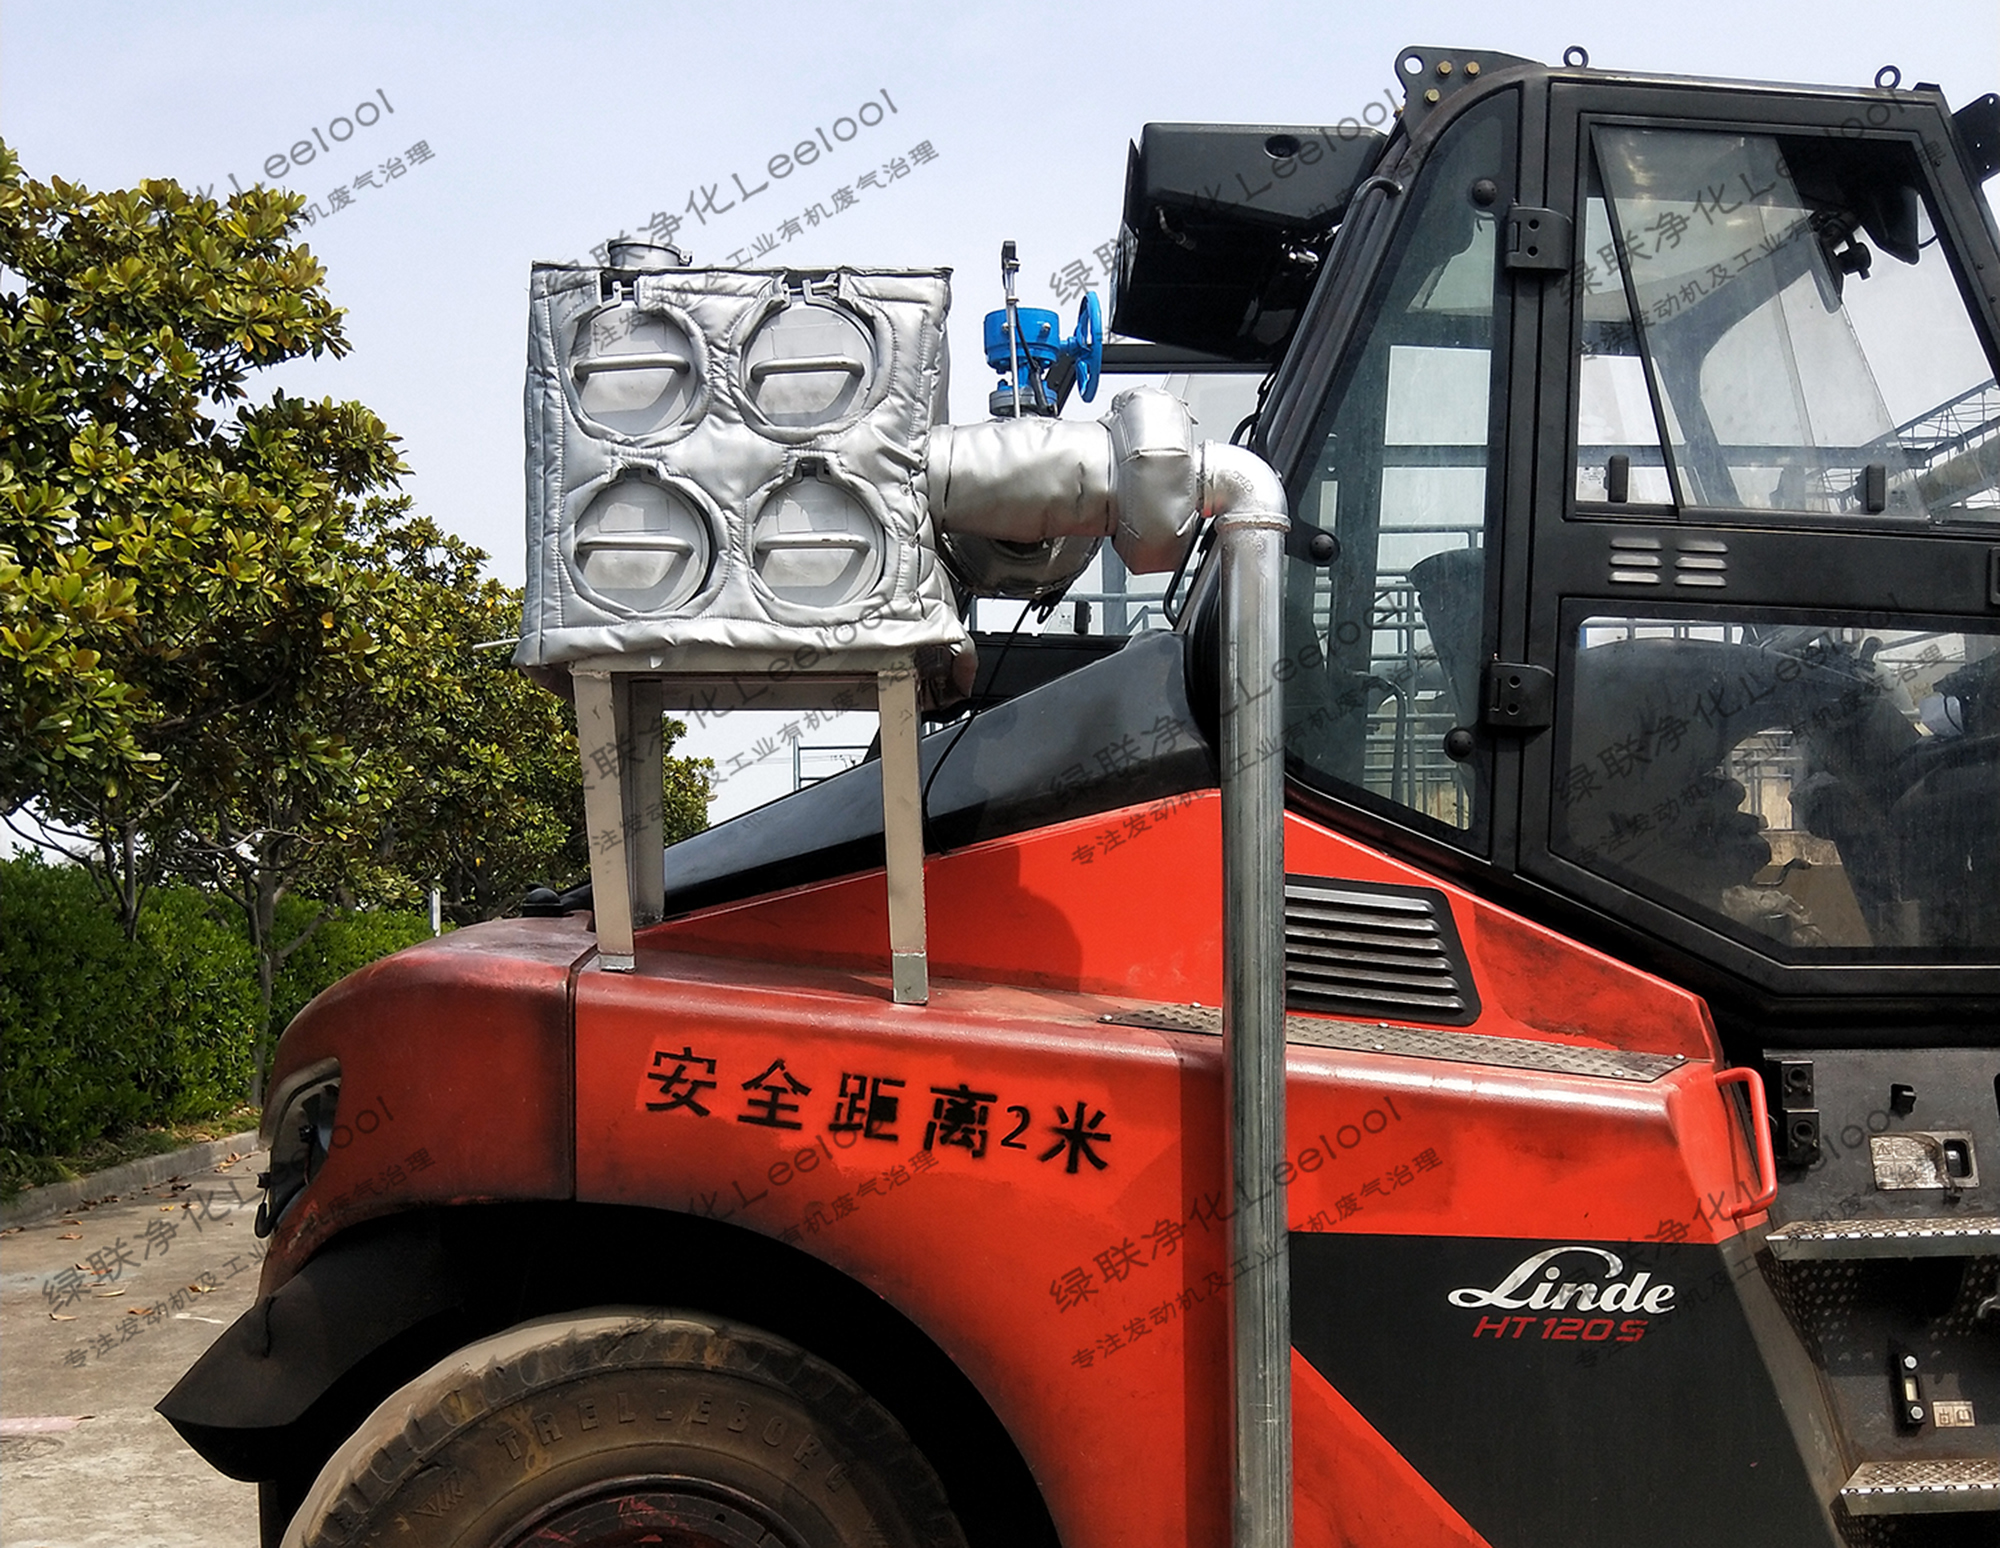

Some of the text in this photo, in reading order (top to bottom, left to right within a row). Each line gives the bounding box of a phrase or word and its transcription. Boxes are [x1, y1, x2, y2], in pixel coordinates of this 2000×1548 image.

[645, 1046, 1112, 1175] 安全距离2米
[1448, 1246, 1676, 1314] Linde
